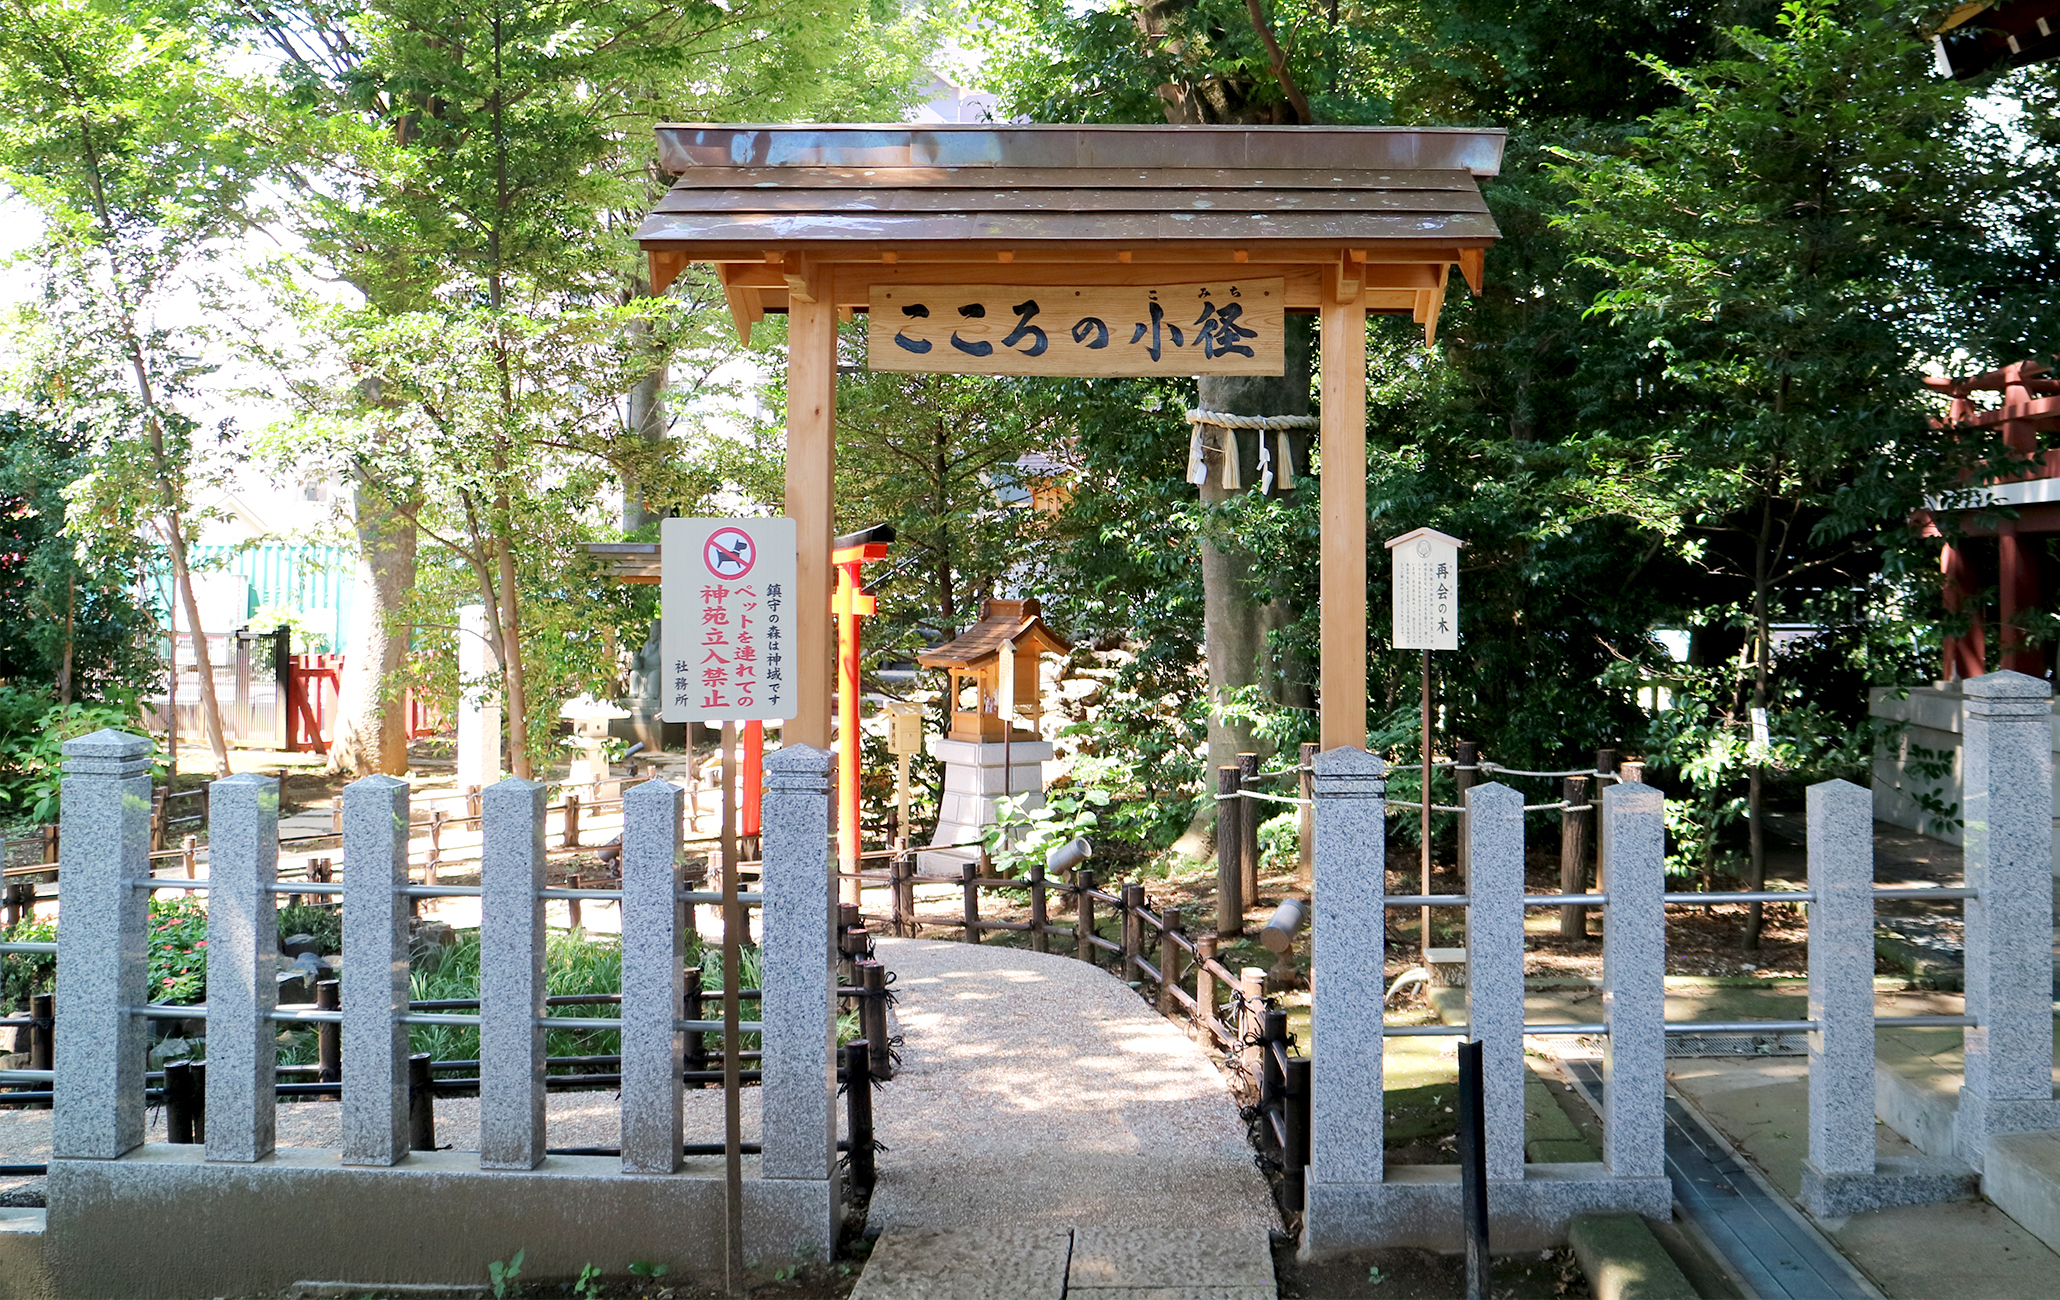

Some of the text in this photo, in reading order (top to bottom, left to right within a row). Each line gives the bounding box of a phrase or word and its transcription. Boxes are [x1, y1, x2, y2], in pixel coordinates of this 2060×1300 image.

[894, 299, 1259, 363] こころの小径
[699, 584, 731, 709] 神苑立入禁止
[733, 585, 758, 708] ペットを連れての
[766, 583, 783, 706] 鎮守の森は神域です
[1436, 562, 1450, 635] 再会の木
[674, 659, 689, 707] 社務所
